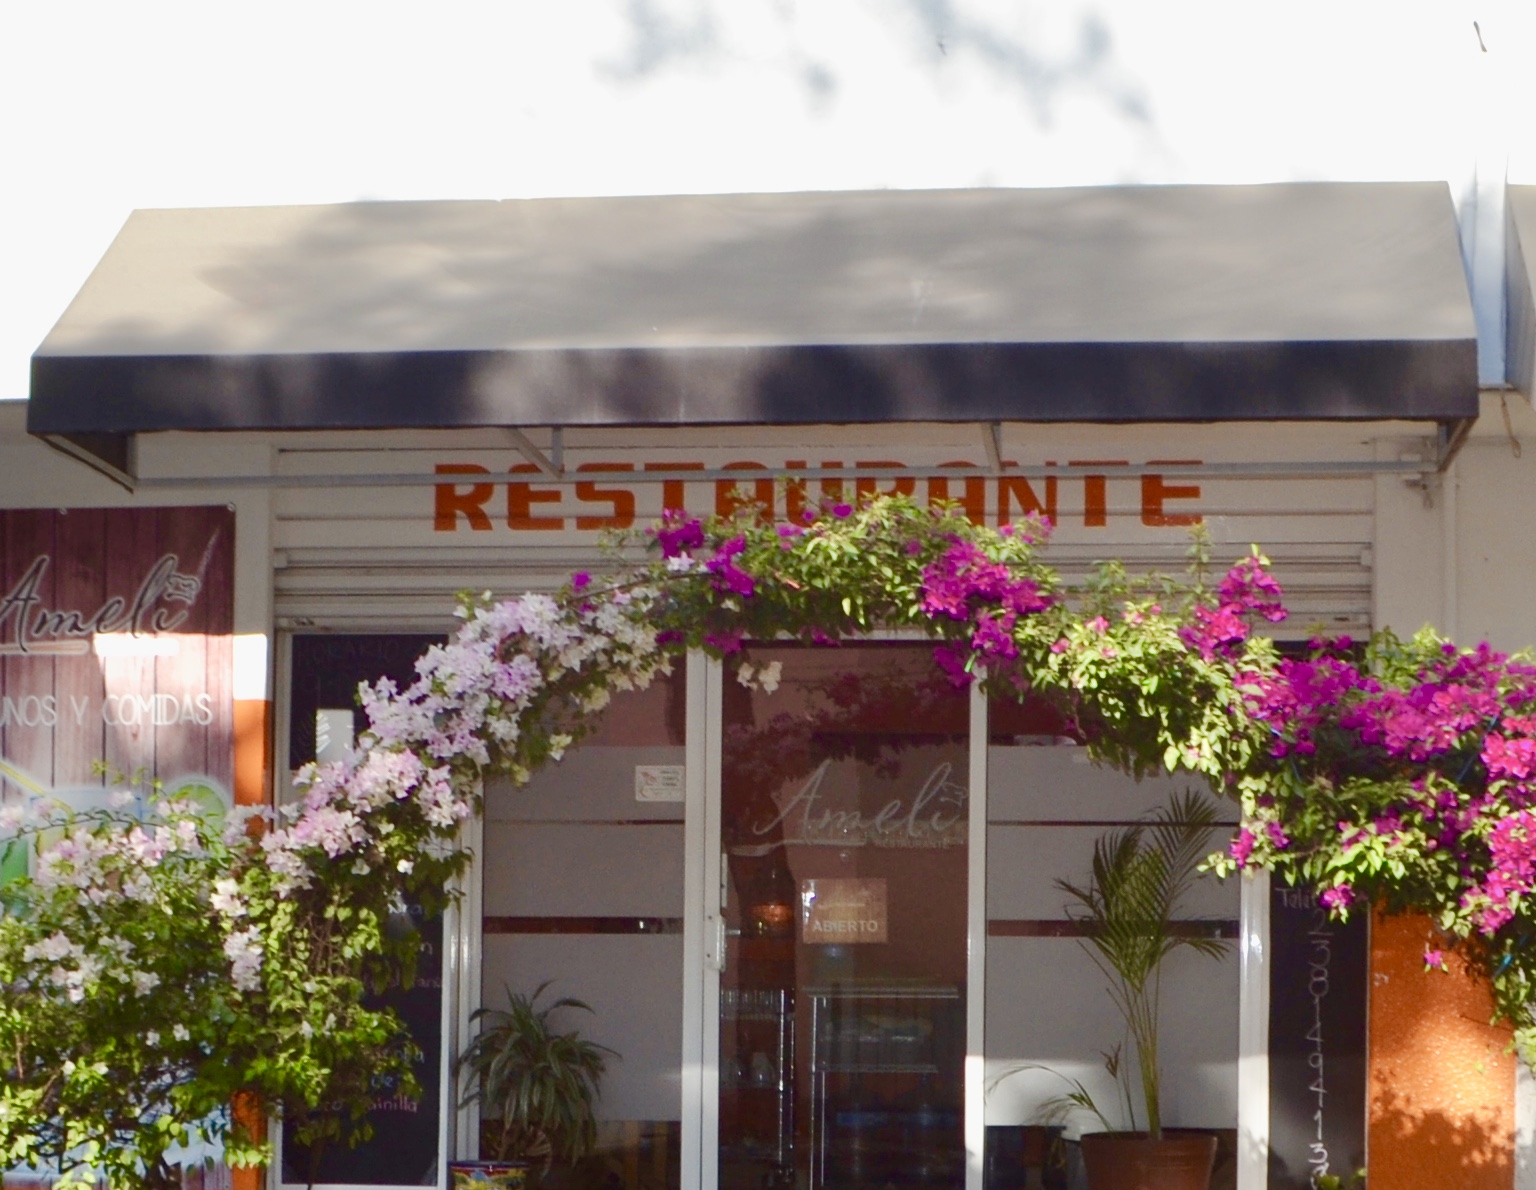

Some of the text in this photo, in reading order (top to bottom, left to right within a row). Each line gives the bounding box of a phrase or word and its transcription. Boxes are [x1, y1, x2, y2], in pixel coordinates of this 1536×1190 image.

[68, 695, 90, 726] Y
[101, 693, 214, 727] COMIDAS
[811, 920, 879, 933] ABIERTO
